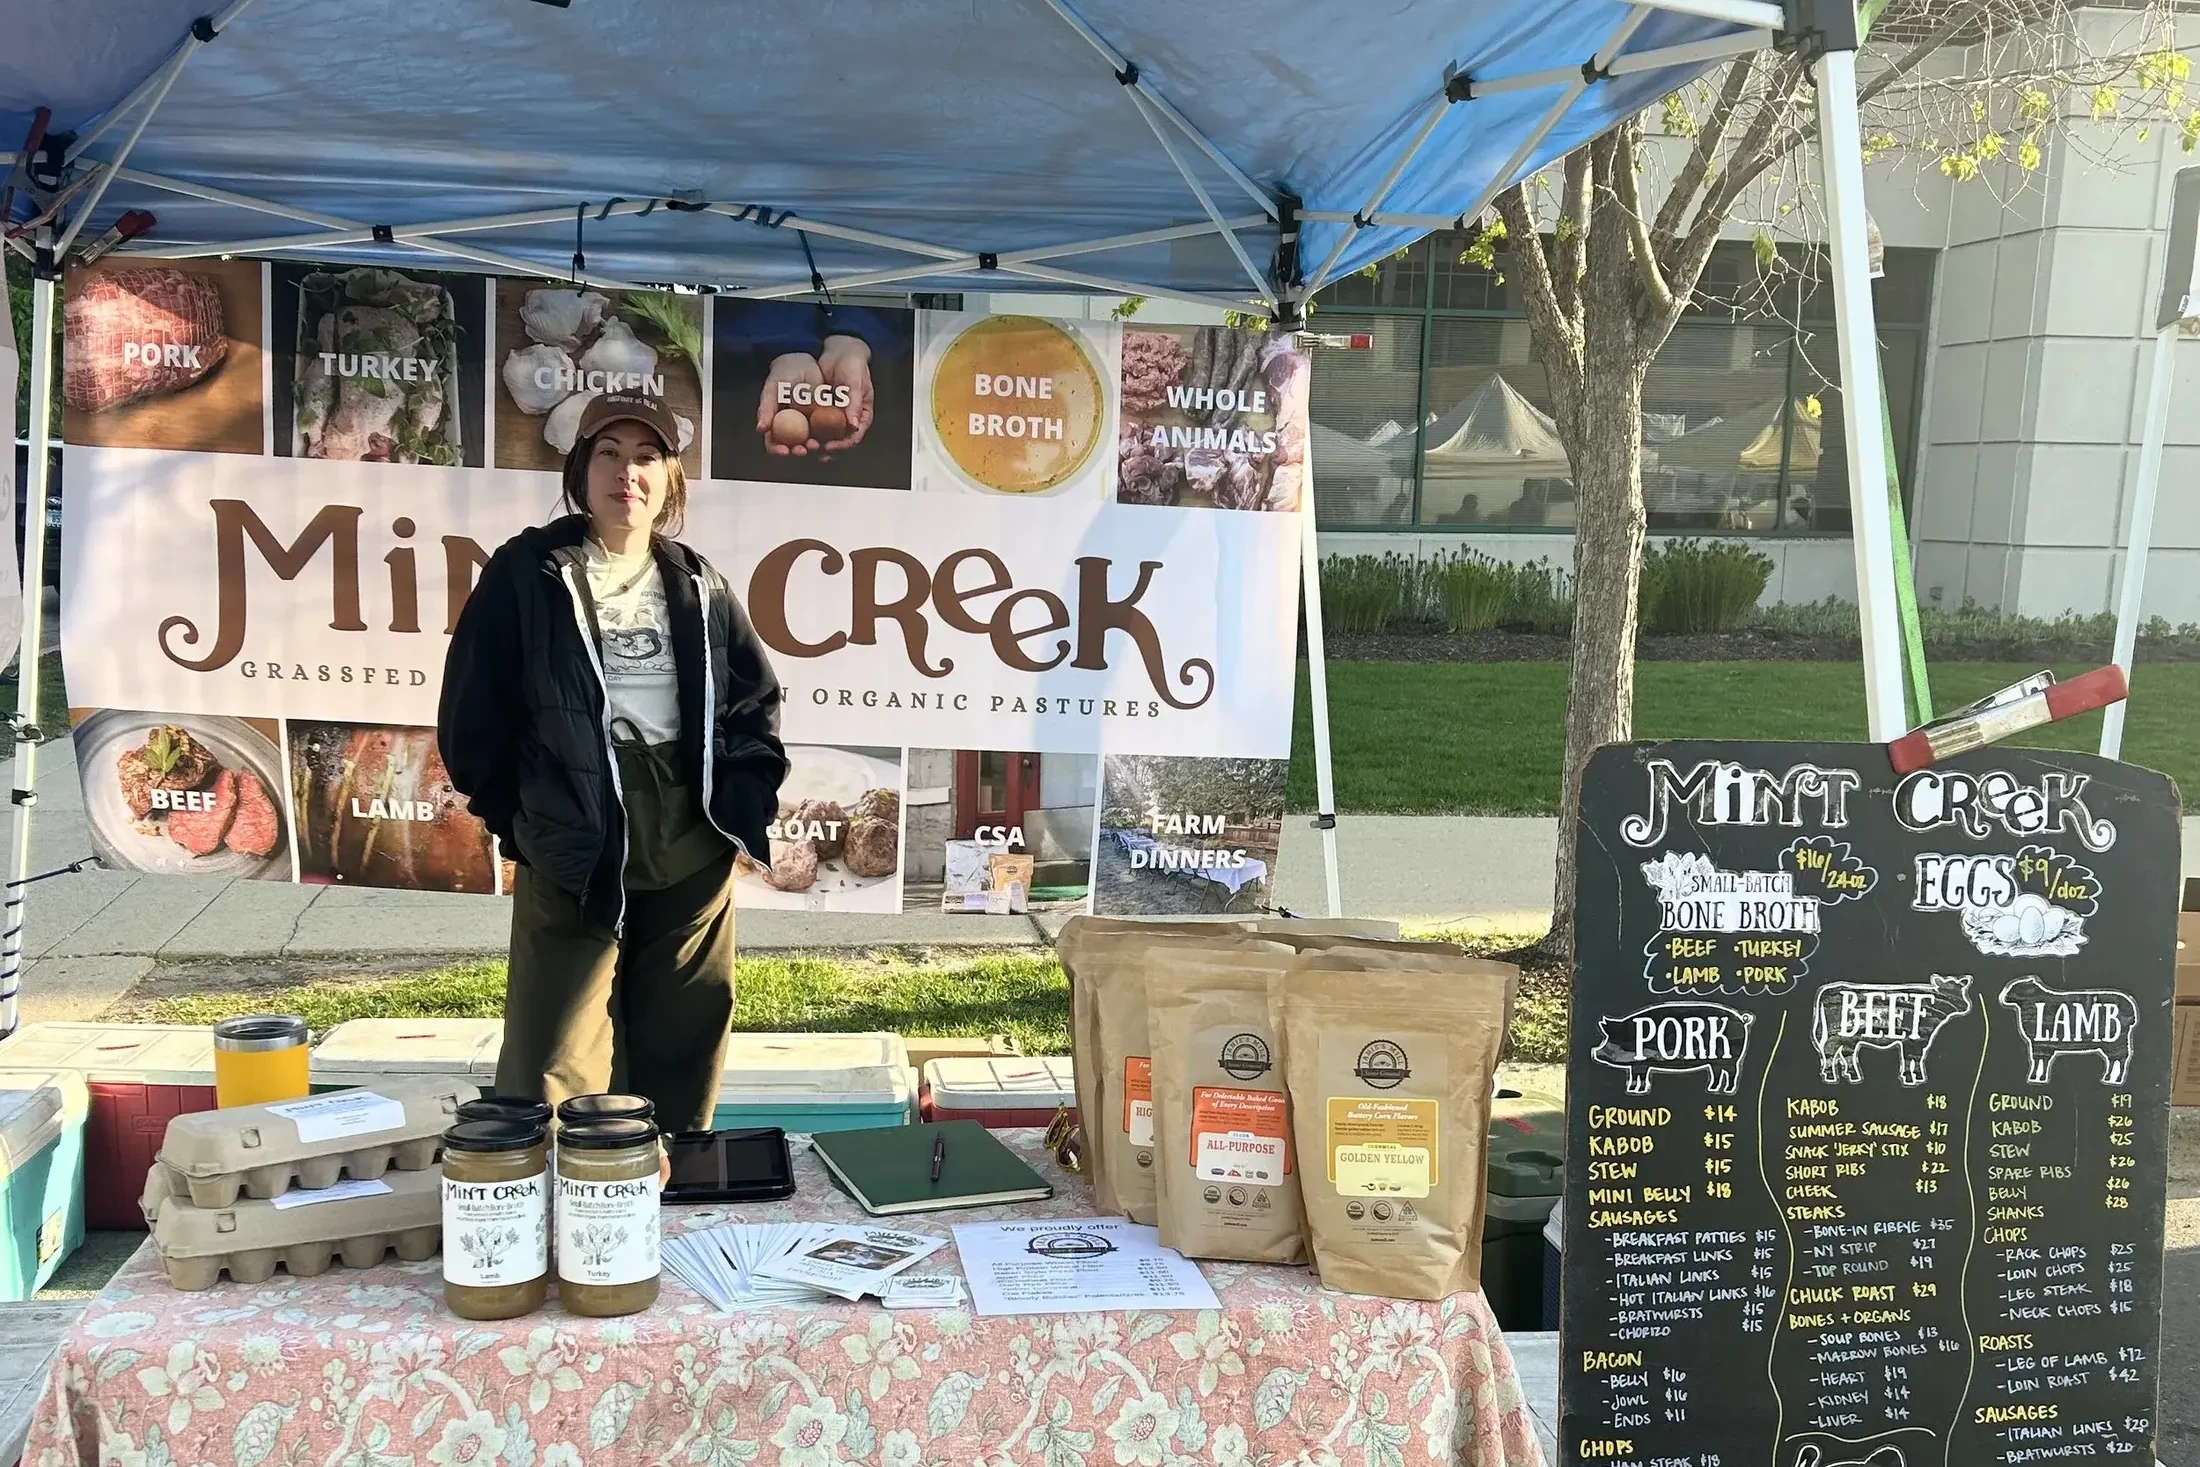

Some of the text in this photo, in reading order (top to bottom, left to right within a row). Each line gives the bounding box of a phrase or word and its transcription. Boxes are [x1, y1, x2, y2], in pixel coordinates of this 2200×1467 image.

[123, 341, 204, 370] PORK
[318, 352, 440, 384] TURKEY
[533, 366, 665, 397] CHICKEN
[974, 373, 1053, 401] BONE
[776, 382, 851, 408] EGGS
[1165, 384, 1267, 414] WHOLE
[967, 413, 1064, 441] BROTH
[1149, 426, 1278, 455] ANIMALS
[239, 658, 1162, 719] GRASSFED ORGANIC PASTURES
[150, 788, 218, 814] BEEF
[350, 797, 435, 824] LAMB
[765, 818, 842, 843] GOAT
[1151, 813, 1226, 836] FARM
[974, 824, 1026, 848] CSA
[1130, 848, 1247, 871] DINNERS
[1692, 875, 1791, 893] SMALL-BATCH
[1916, 857, 2016, 908] EGGS
[1663, 901, 1818, 930] BONE BROTH
[1671, 938, 1802, 959] BEEF TURKEY
[1673, 966, 1788, 985] LAMB PORK
[1836, 990, 1935, 1042] BEEF
[2033, 1002, 2123, 1044] LAMB
[1632, 1016, 1733, 1061] PORK
[1787, 1094, 1947, 1118] KABOB $18
[1989, 1093, 2132, 1112] GROUND $19
[1588, 1104, 1737, 1128] GROUND $14
[1789, 1120, 1949, 1140] SUMMER SAUSAGE $17
[1991, 1115, 2133, 1138] KABOB $26
[1207, 1139, 1275, 1155] ALL-PURPOSE
[1588, 1132, 1734, 1156] KABOB $15
[1785, 1144, 1829, 1160] SNACK
[1881, 1143, 1910, 1157] STIX
[1925, 1141, 1946, 1155] $10
[1989, 1132, 2134, 1159] STEW $25
[1340, 1152, 1425, 1165] GOLDEN YELLOW
[1988, 1155, 2135, 1180] SPARE RIBS $26
[1588, 1158, 1732, 1180] STEW $15
[1785, 1160, 1950, 1181] SHORT RIBS $22
[1588, 1181, 1732, 1205] MINI BELLY $18
[1785, 1178, 1938, 1200] CHEEK $13
[1988, 1176, 2130, 1201] BELLY $26
[1786, 1204, 1846, 1220] STEAKS
[1987, 1194, 2128, 1221] SHANKS $28
[1030, 1224, 1083, 1232] proudly
[1587, 1209, 1678, 1228] SAUSAGES
[1873, 1220, 1921, 1235] RIBEYE
[1930, 1217, 1956, 1231] $35
[1695, 1229, 1776, 1245] PATTIES $15
[1983, 1225, 2028, 1244] CHOPS
[1693, 1247, 1774, 1262] LINKS $15
[1840, 1238, 1936, 1255] STRIP $27
[2049, 1243, 2136, 1260] CHOPS $25
[587, 1270, 611, 1279] Turkey
[1679, 1265, 1774, 1284] LINKS $15
[1842, 1255, 1934, 1275] ROUND $19
[2045, 1261, 2135, 1277] CHOPS $25
[1652, 1284, 1776, 1305] ITALIAN LINKS $16
[1789, 1281, 1937, 1305] CHUCK ROAST $29
[2043, 1279, 2133, 1297] STEAK $18
[1742, 1301, 1765, 1316] $15
[2057, 1300, 2133, 1317] CHOPS $15
[1742, 1319, 1763, 1332] $15
[1788, 1313, 1835, 1330] BONES
[1859, 1326, 1939, 1343] BONES $13
[1979, 1334, 2034, 1353] ROASTS
[1883, 1339, 1960, 1359] BONES $16
[1583, 1350, 1643, 1372] BACON
[2041, 1355, 2059, 1368] OF
[2064, 1352, 2108, 1367] LAMB
[1662, 1366, 1687, 1383] $16
[1884, 1365, 1908, 1382] $19
[2047, 1366, 2140, 1389] ROAST $42
[1665, 1387, 1688, 1402] $16
[1884, 1385, 1911, 1401] $14
[1664, 1408, 1686, 1422] $11
[1884, 1406, 1910, 1420] $14
[1974, 1404, 2059, 1424] SAUSAGES
[2072, 1420, 2113, 1436] LINKS
[1579, 1439, 1634, 1458] CHOPS
[1700, 1453, 1720, 1467] $18
